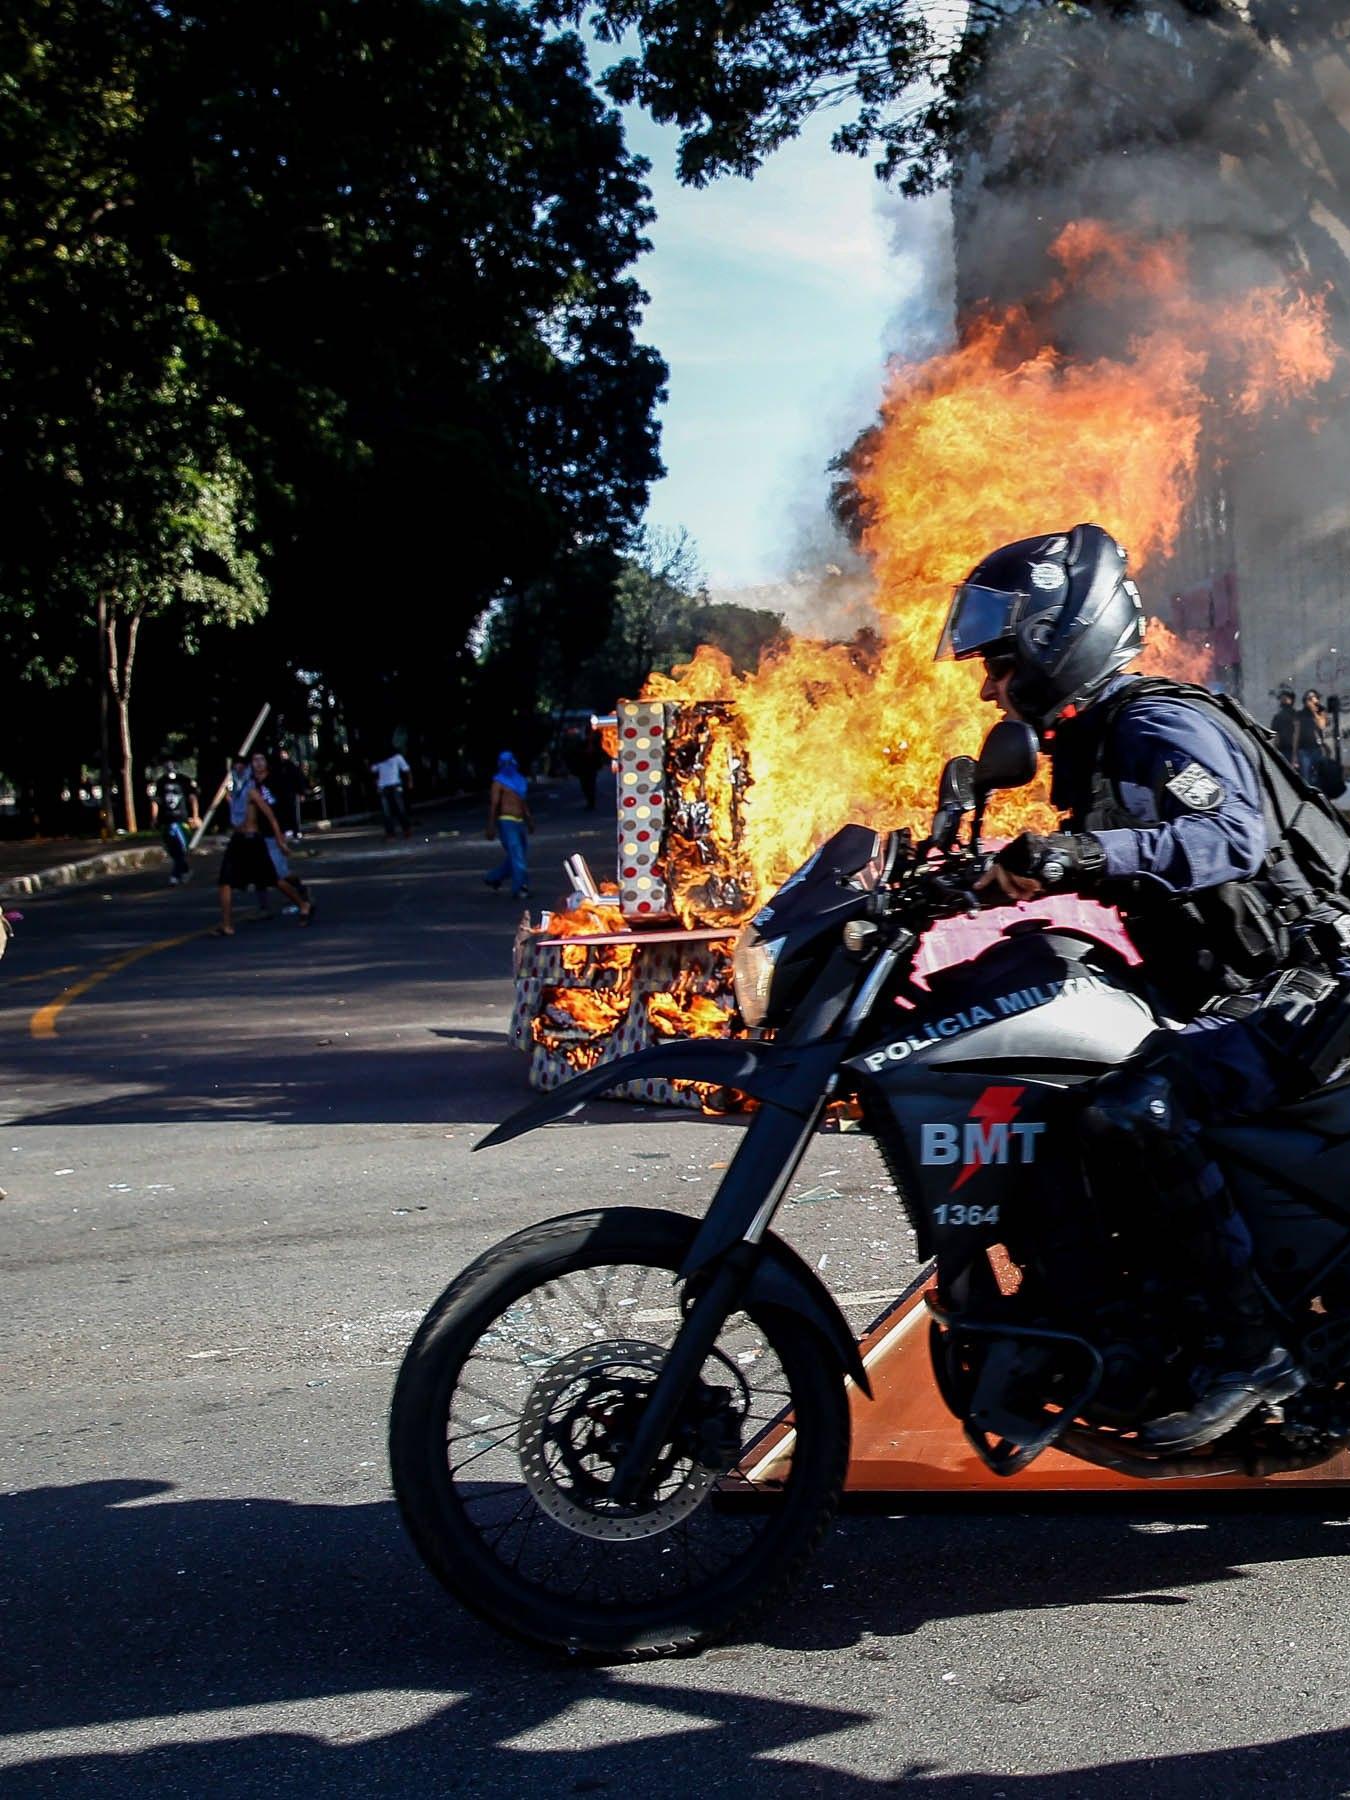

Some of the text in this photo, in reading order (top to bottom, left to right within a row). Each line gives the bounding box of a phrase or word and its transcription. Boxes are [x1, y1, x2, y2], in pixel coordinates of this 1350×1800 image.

[995, 976, 1110, 1014] MILIT
[920, 1122, 1046, 1165] BMT
[933, 1203, 1000, 1226] 1364
